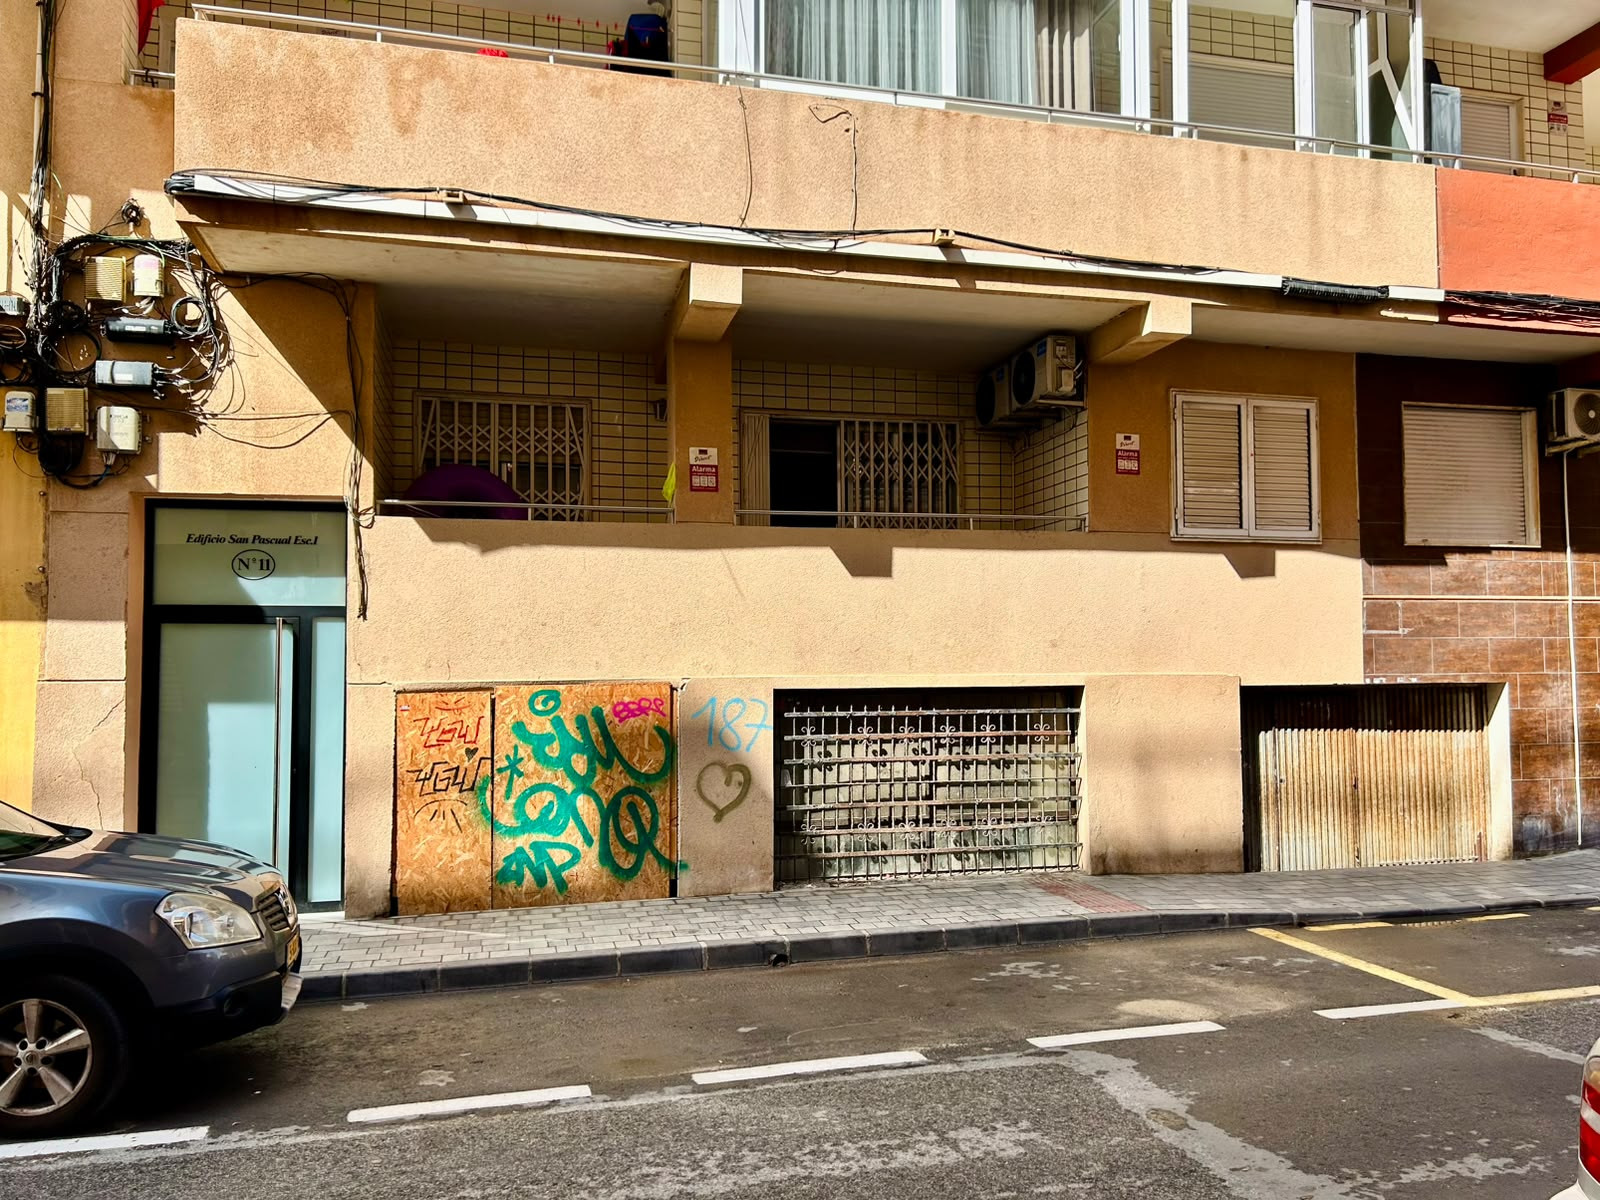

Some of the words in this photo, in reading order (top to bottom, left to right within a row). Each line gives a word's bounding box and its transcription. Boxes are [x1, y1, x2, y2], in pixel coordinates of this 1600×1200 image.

[186, 533, 226, 546] Edificio
[228, 534, 249, 544] San
[251, 534, 292, 545] Pascual
[691, 696, 773, 752] 187
